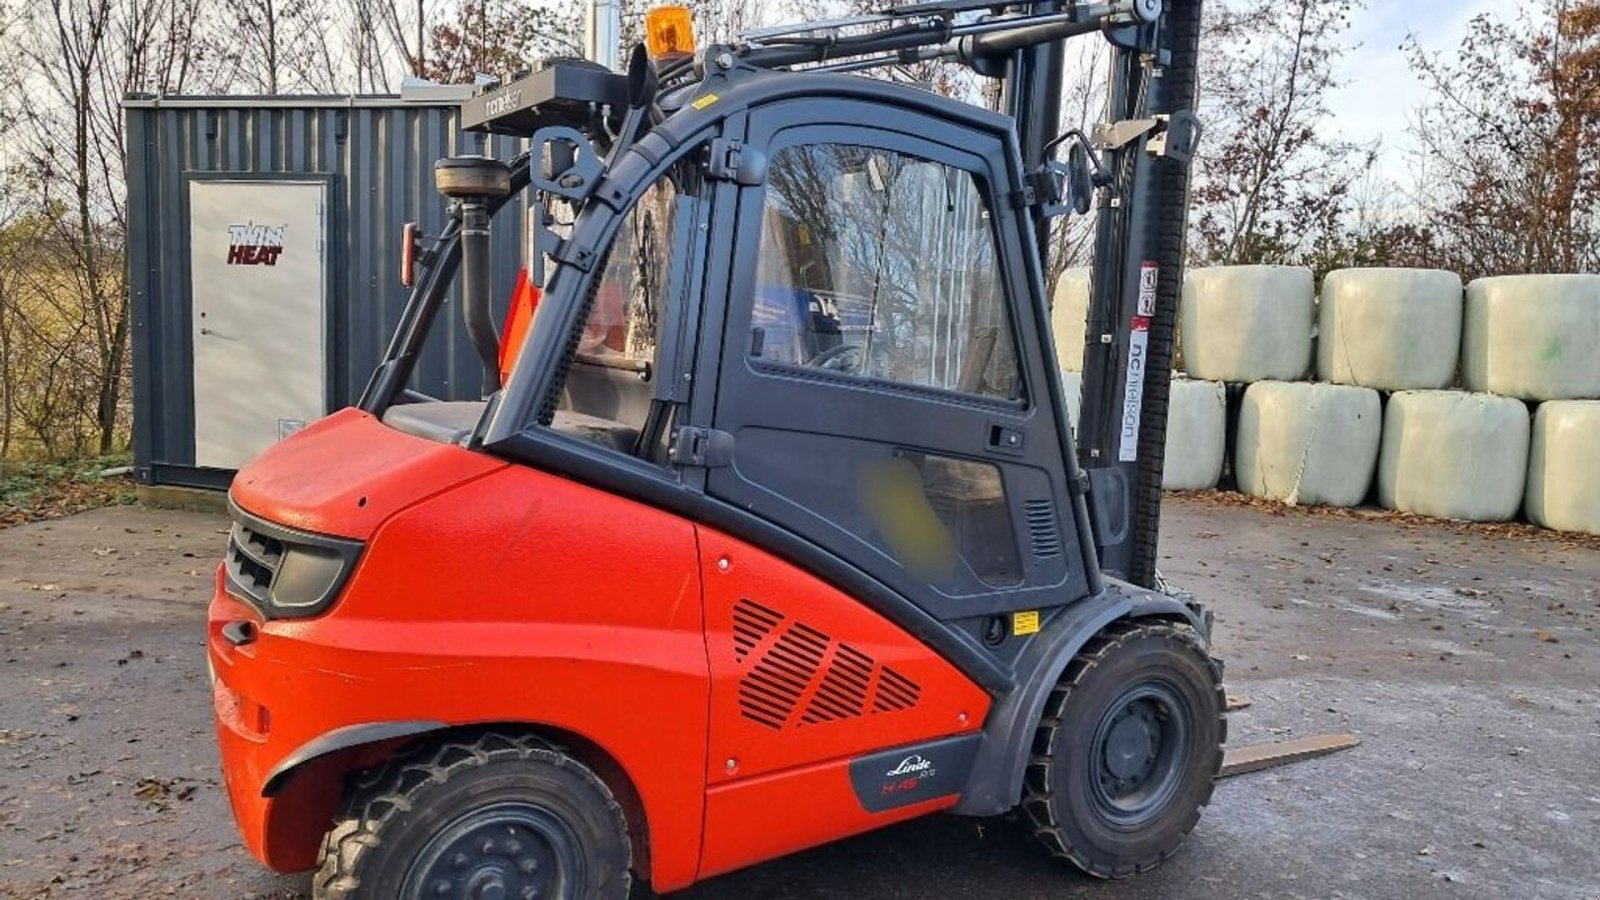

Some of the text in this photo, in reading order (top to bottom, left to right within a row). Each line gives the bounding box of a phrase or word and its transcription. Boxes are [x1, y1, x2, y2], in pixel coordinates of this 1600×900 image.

[228, 220, 284, 246] TWIN
[227, 245, 282, 266] HEAT
[886, 755, 931, 776] Linde
